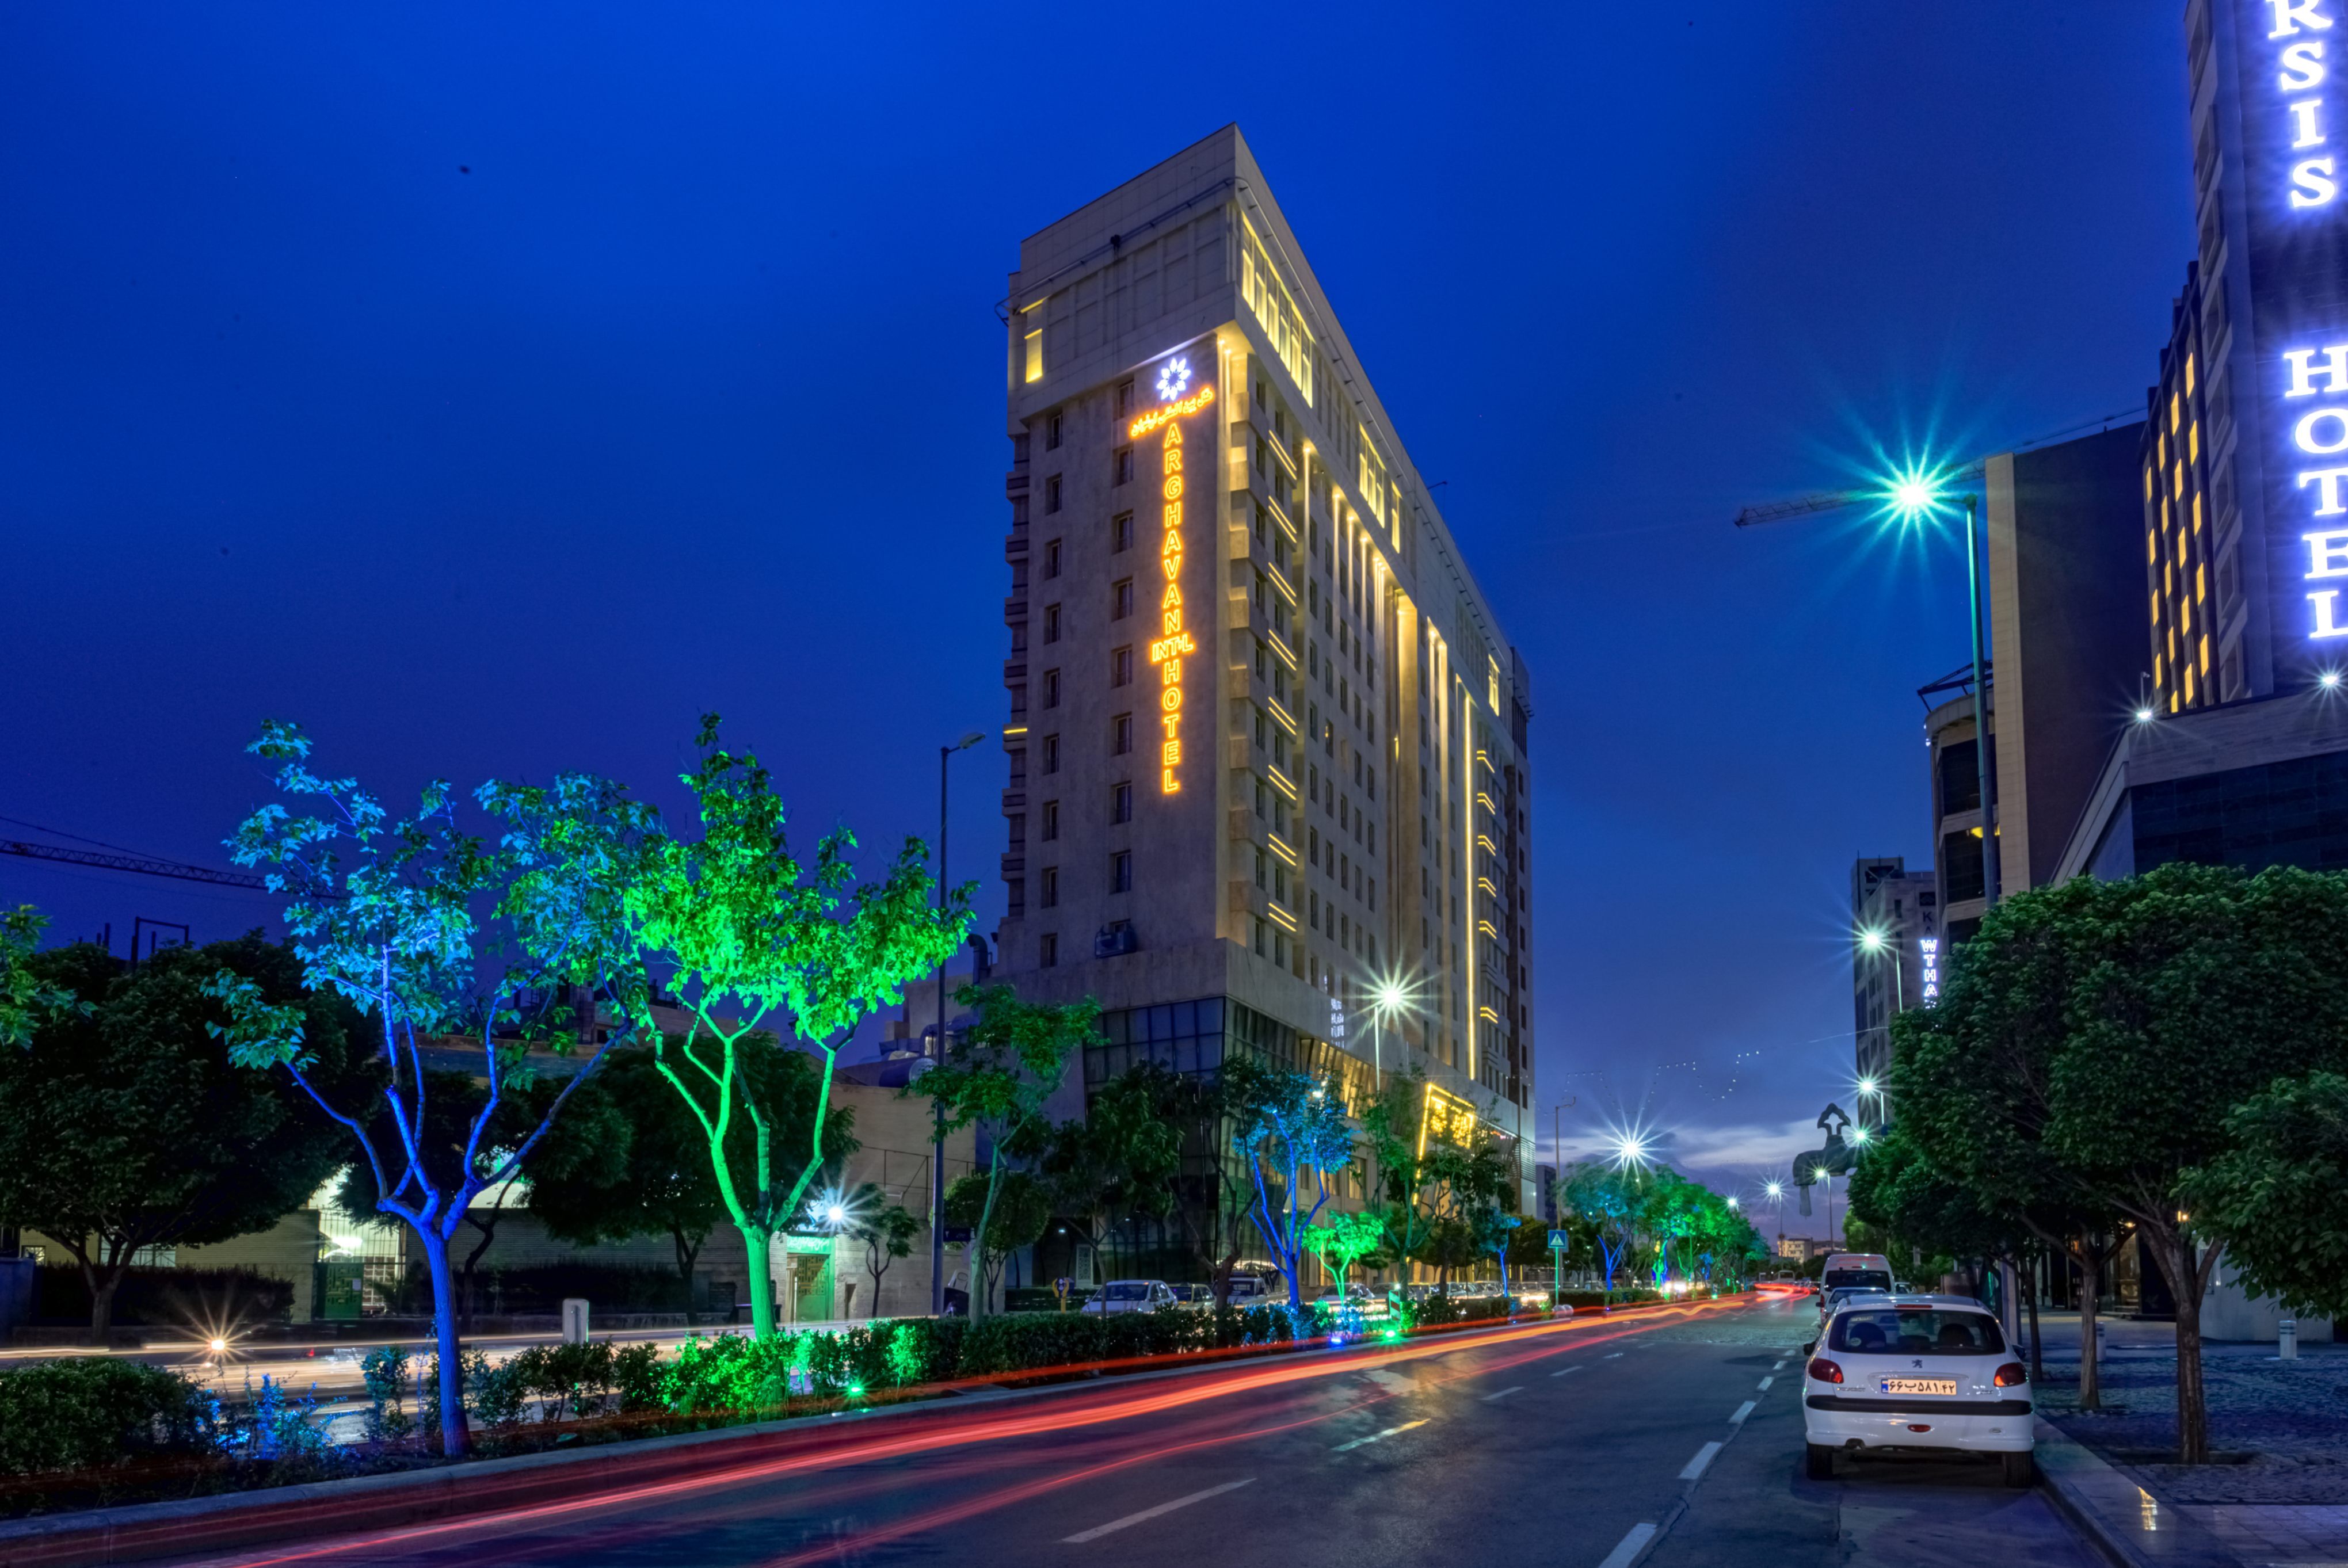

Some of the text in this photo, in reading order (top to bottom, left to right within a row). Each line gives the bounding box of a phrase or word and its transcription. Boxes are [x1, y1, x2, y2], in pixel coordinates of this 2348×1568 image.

[1163, 422, 1182, 635] ARGHAVAN
[2284, 345, 2348, 638] HOTEL
[1163, 659, 1181, 793] HOTEL
